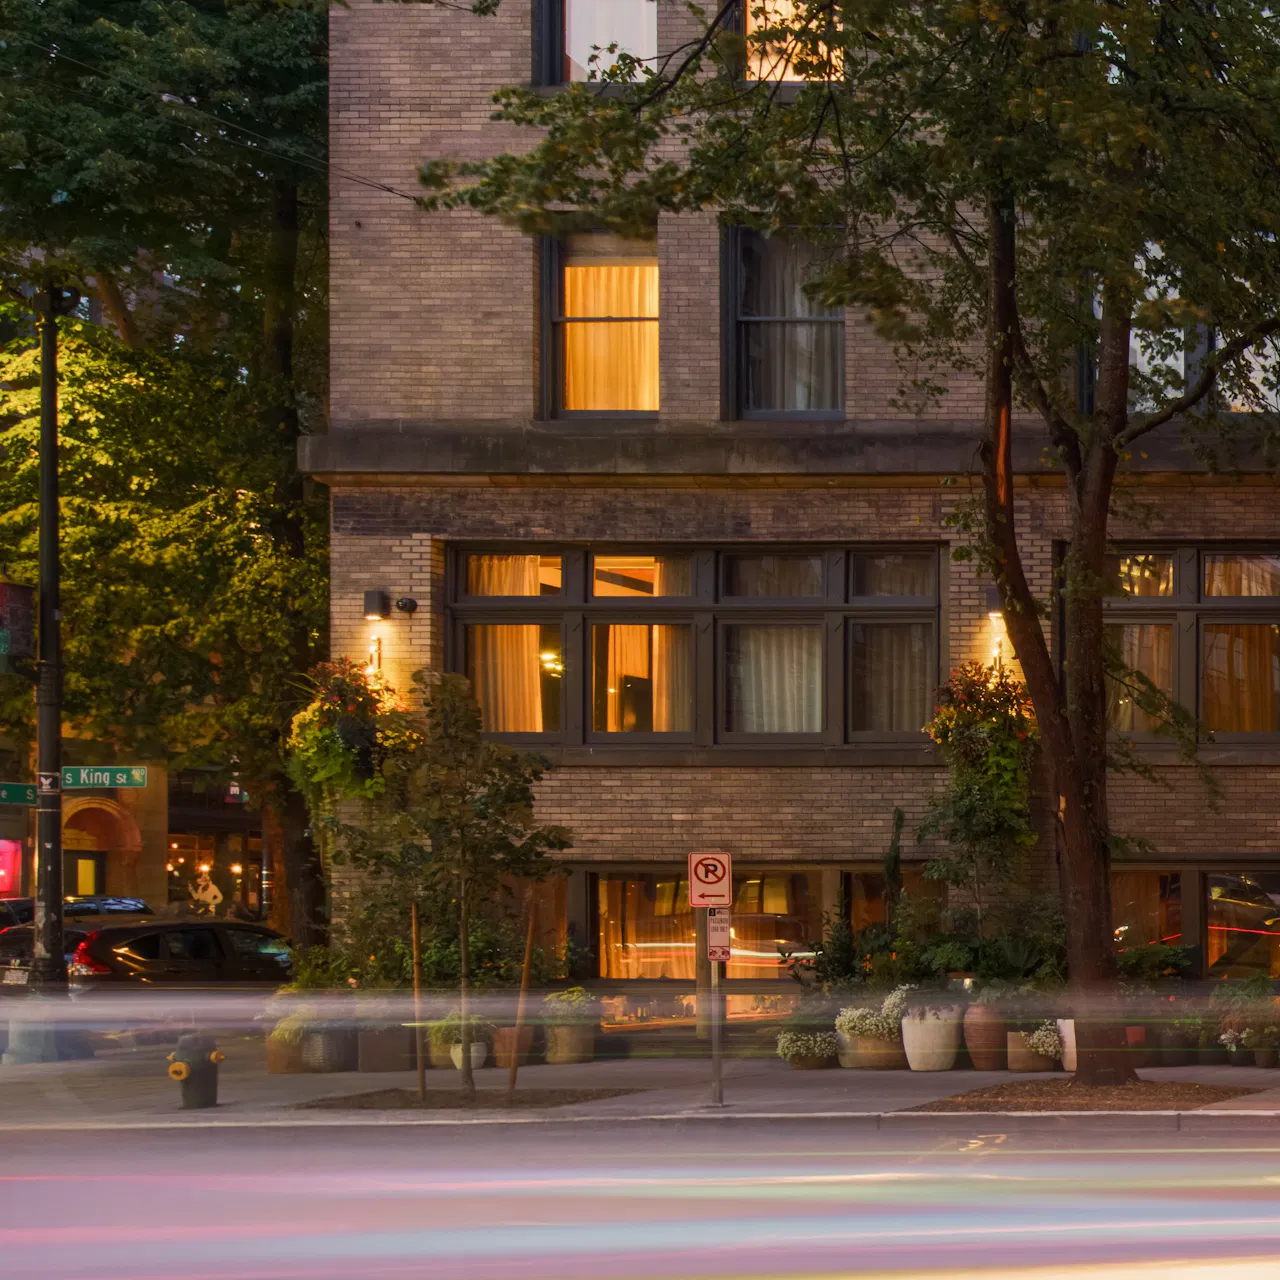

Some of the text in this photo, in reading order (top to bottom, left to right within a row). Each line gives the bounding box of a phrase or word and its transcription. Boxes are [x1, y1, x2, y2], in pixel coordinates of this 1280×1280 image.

[80, 769, 110, 786] King
[116, 773, 127, 784] St
[26, 788, 34, 800] S
[704, 863, 718, 879] P
